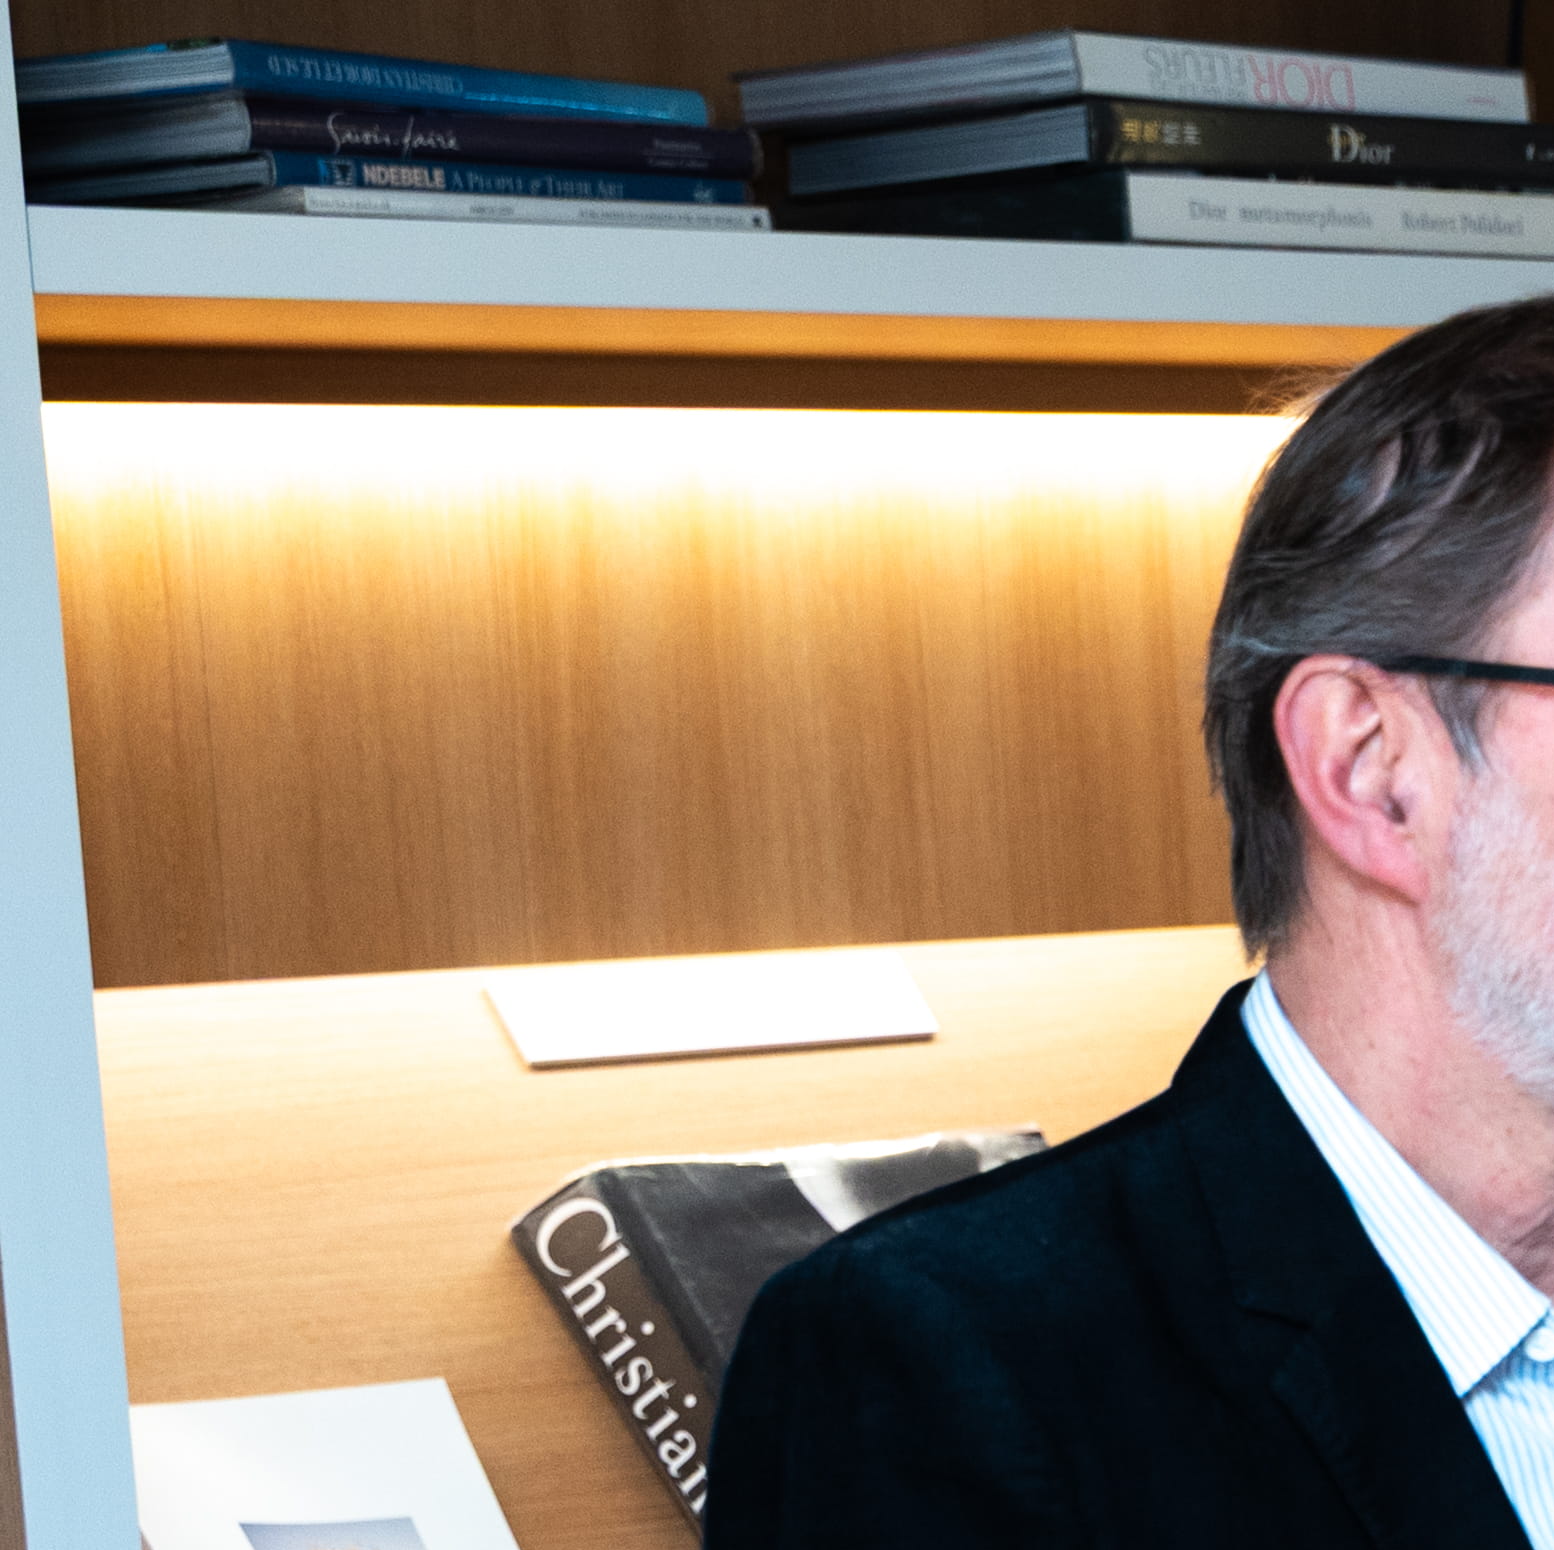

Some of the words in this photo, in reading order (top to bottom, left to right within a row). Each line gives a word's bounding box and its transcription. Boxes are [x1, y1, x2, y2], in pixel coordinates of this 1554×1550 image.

[1247, 54, 1355, 110] DIOR
[1328, 123, 1396, 167] Dior
[362, 163, 446, 190] NDEBELE
